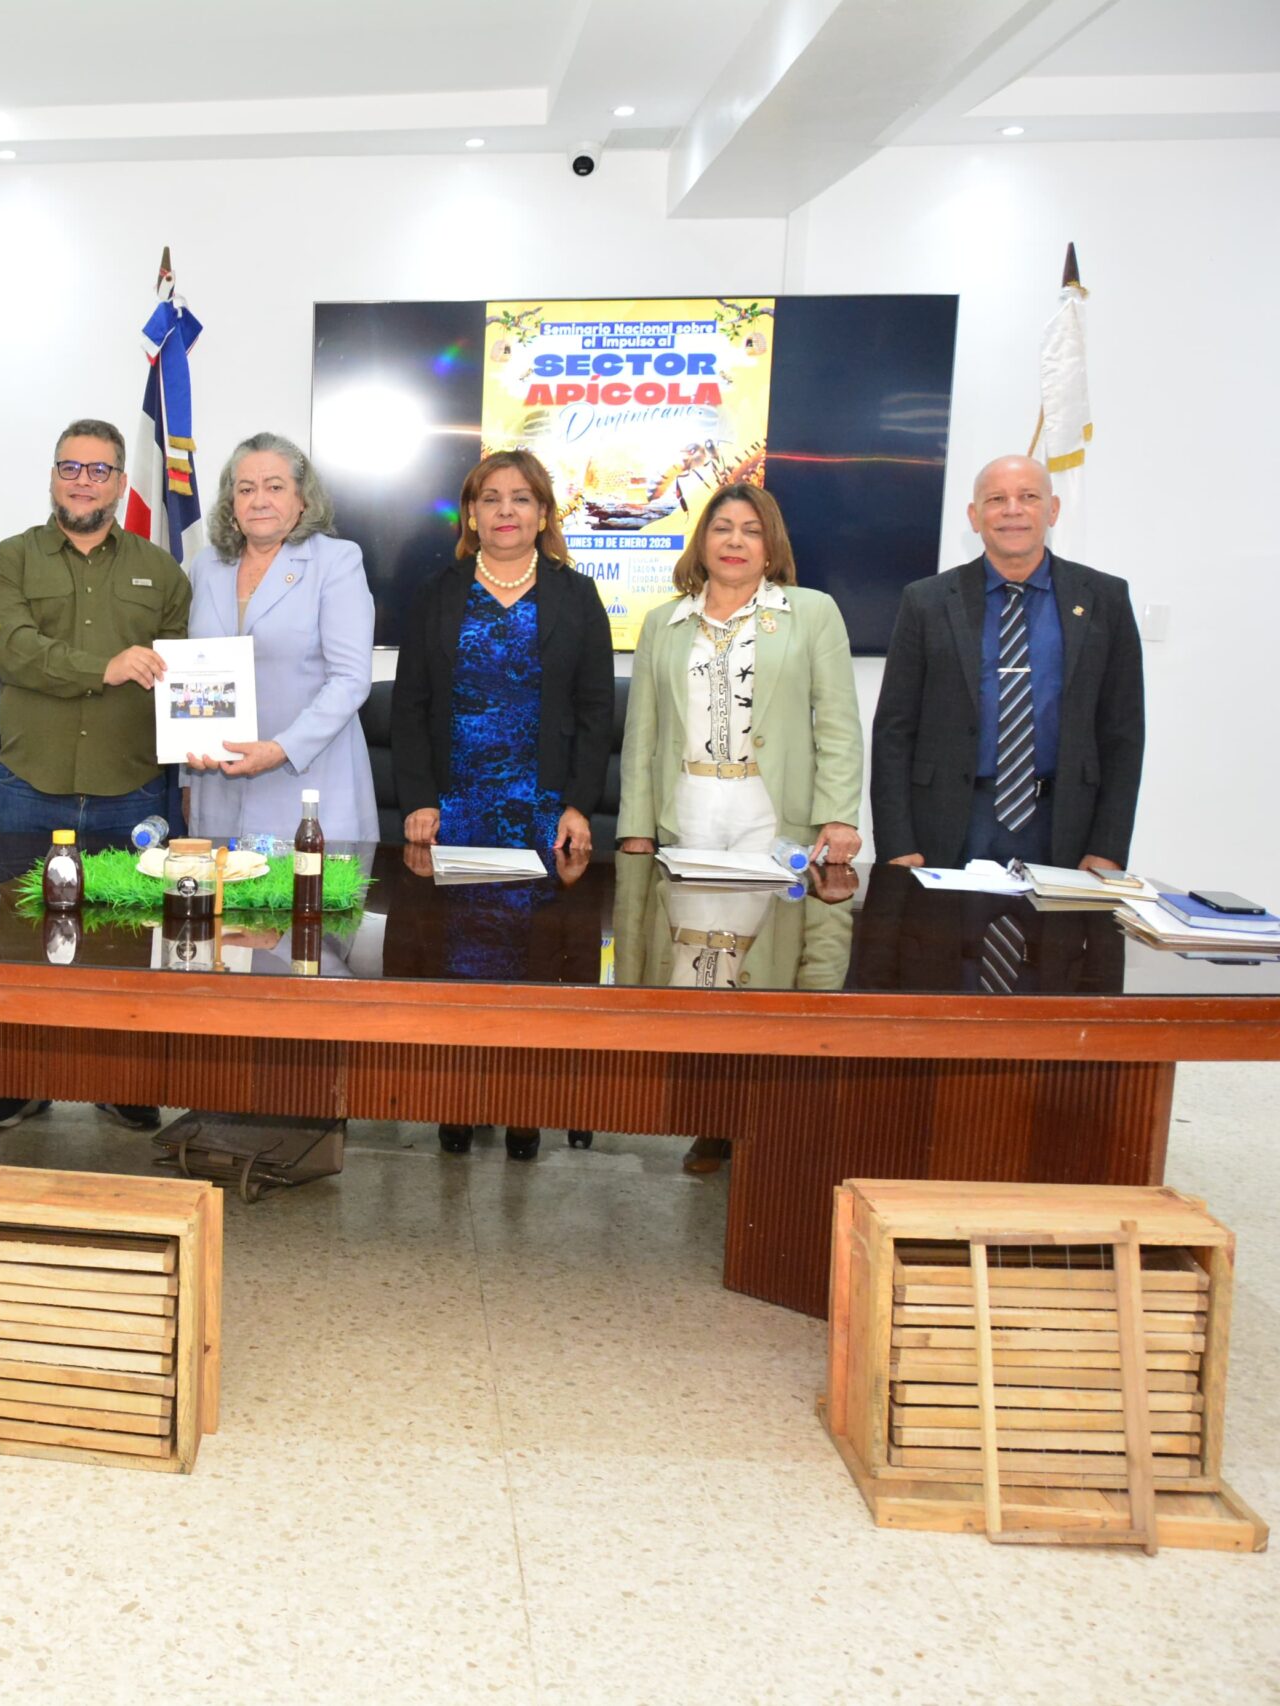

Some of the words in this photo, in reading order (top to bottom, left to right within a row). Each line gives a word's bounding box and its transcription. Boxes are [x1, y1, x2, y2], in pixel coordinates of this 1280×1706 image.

[543, 324, 611, 335] Seminario
[614, 323, 673, 334] Nacional
[676, 322, 714, 333] sobre
[583, 337, 596, 347] el
[602, 336, 655, 348] Impulso
[658, 336, 671, 346] al
[533, 353, 717, 377] SECTOR
[523, 374, 722, 406] APÍCOLA
[566, 537, 592, 548] LUNES
[593, 537, 604, 547] 19
[606, 537, 617, 547] DE
[619, 537, 647, 548] ENERO
[649, 537, 671, 548] 2026
